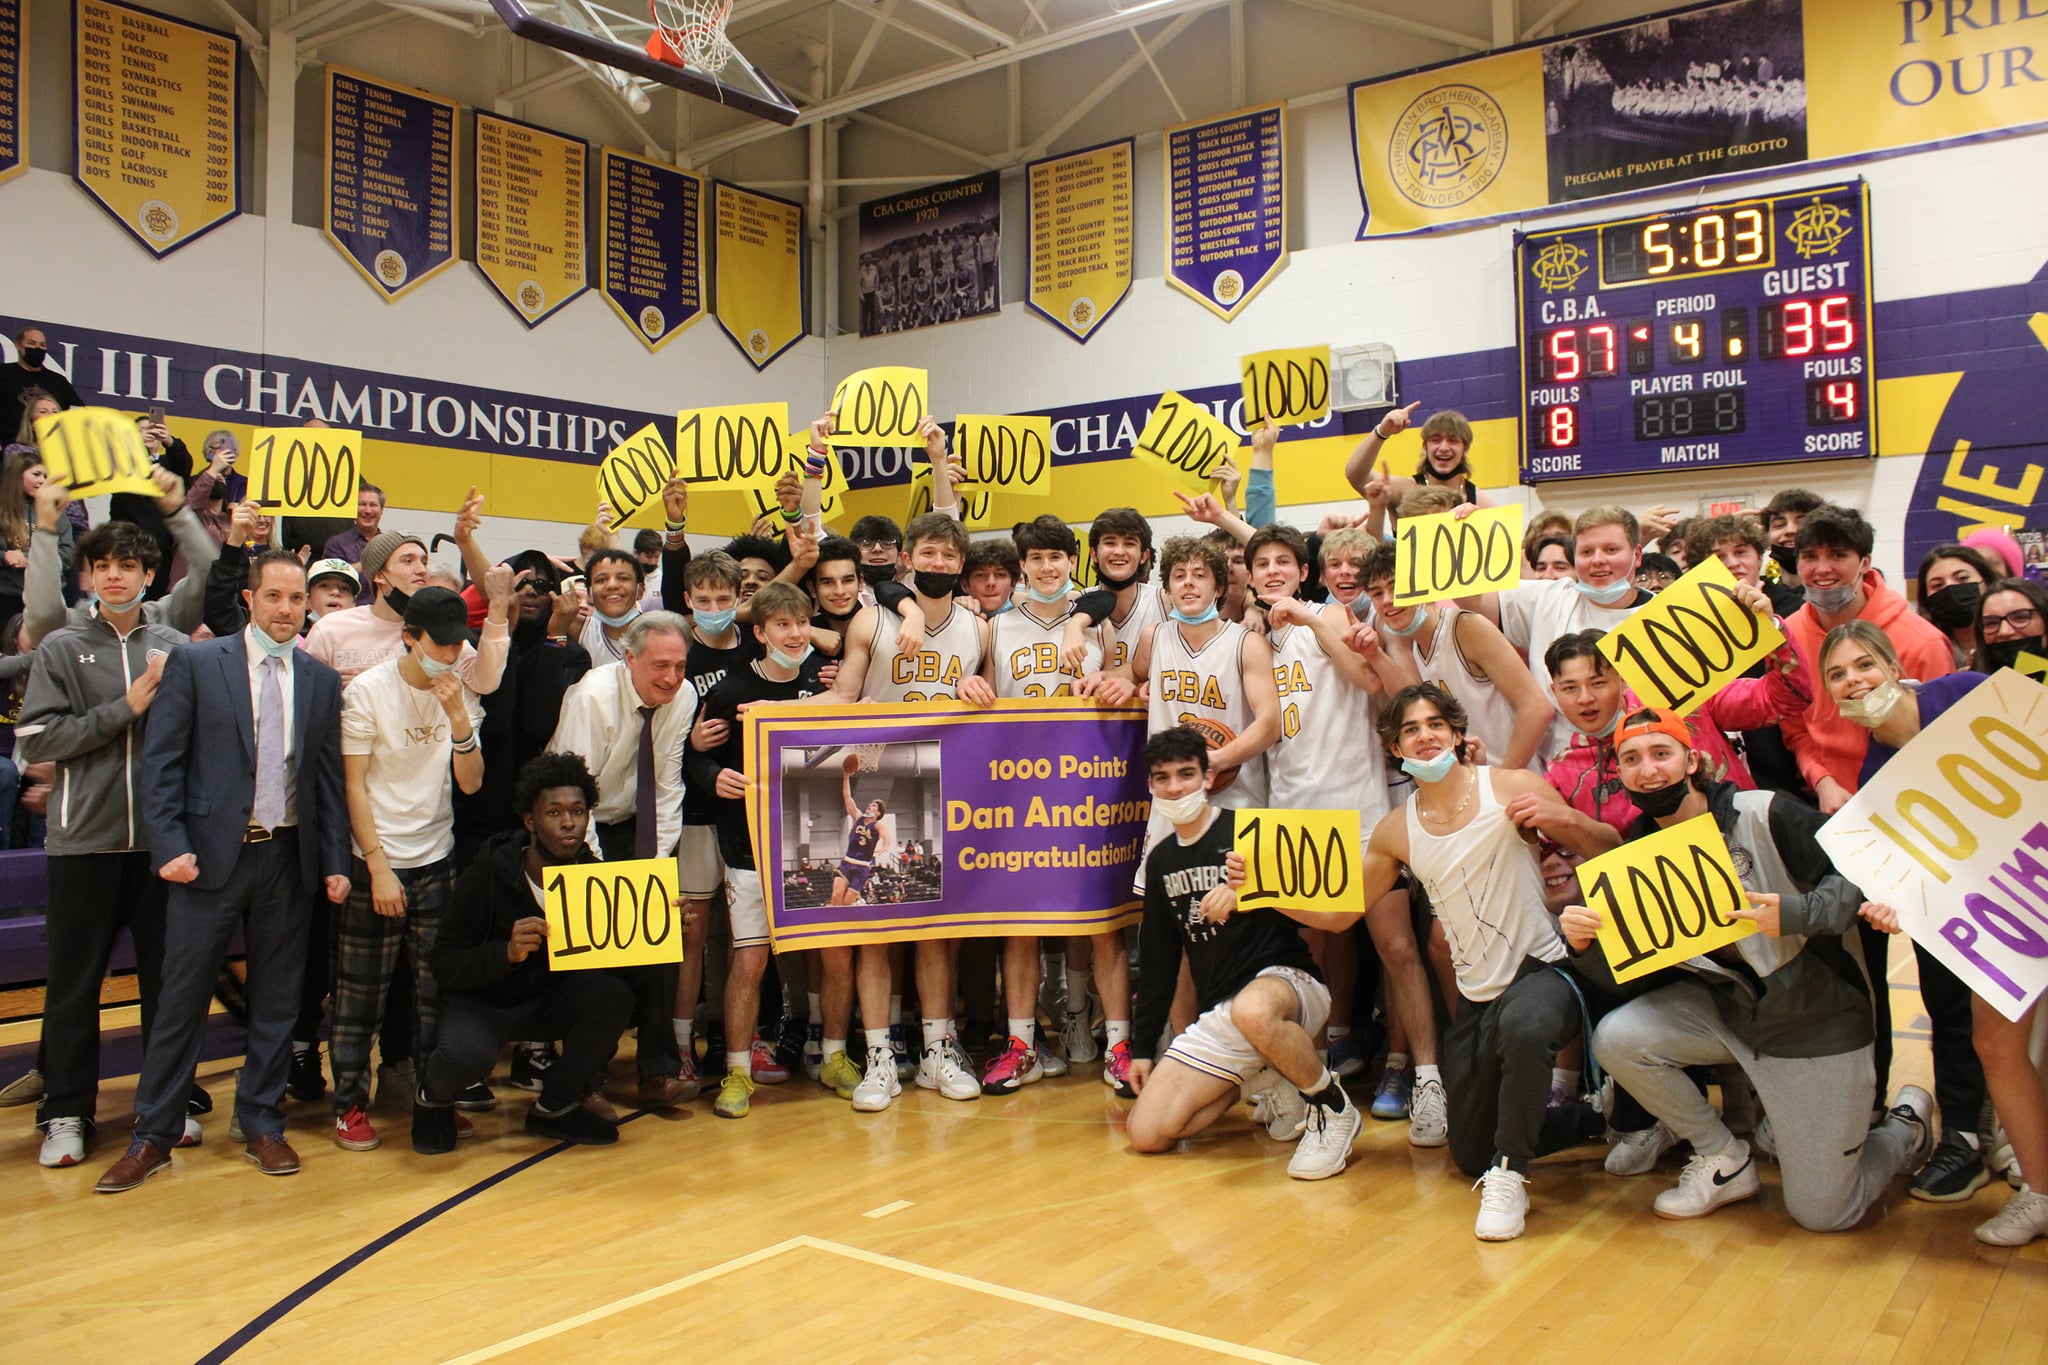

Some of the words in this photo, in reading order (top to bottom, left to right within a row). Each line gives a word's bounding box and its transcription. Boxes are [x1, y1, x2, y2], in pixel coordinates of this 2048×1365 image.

[84, 5, 111, 20] BOYS
[121, 15, 170, 38] BASEBALL
[208, 41, 229, 55] 2006
[84, 19, 114, 34] GIRLS
[121, 29, 146, 43] GOLF
[208, 54, 229, 67] 2006
[84, 32, 111, 47] BOYS
[121, 42, 169, 63] LACROSSE
[208, 66, 229, 80] 2006
[84, 45, 111, 60] BOYS
[121, 55, 156, 73] TENNIS
[208, 79, 228, 92] 2006
[84, 58, 111, 73] BOYS
[121, 68, 182, 92] GYMNASTICS
[208, 91, 228, 105] 2006
[85, 71, 111, 86] BOYS
[121, 82, 158, 98] SOCCER
[207, 104, 228, 117] 2006
[336, 79, 360, 93] GIRLS
[365, 87, 392, 102] TENNIS
[1889, 46, 2047, 107] OUR
[85, 85, 114, 100] GIRLS
[121, 94, 175, 116] SWIMMING
[207, 117, 228, 130] 2006
[85, 98, 114, 113] GIRLS
[121, 107, 156, 124] TENNIS
[207, 129, 227, 142] 2006
[336, 90, 356, 104] BOYS
[365, 99, 407, 118] SWIMMING
[336, 102, 356, 115] BOYS
[364, 110, 402, 128] BASEBALL
[1394, 111, 1418, 176] CHRISTIAN
[1416, 90, 1481, 113] BROTHERS
[1480, 101, 1503, 160] ACADEMY
[1034, 179, 1049, 189] BOYS
[1055, 172, 1075, 183] CROSS
[1075, 166, 1104, 177] COUNTRY
[1564, 166, 1624, 188] PREGAME
[1626, 157, 1675, 177] PRAYER
[1677, 153, 1694, 167] AT
[1697, 147, 1725, 163] THE
[1727, 136, 1789, 157] GROTTO
[481, 176, 502, 188] GIRLS
[506, 183, 538, 198] LACROSSE
[481, 187, 499, 199] BOYS
[506, 193, 530, 206] TENNIS
[873, 203, 894, 218] CBA
[896, 194, 929, 212] CROSS
[931, 182, 984, 204] COUNTRY
[1034, 190, 1050, 199] BOYS
[1056, 183, 1075, 194] CROSS
[1076, 177, 1104, 189] COUNTRY
[1174, 201, 1192, 211] BOYS
[1198, 194, 1221, 206] CROSS
[1221, 187, 1254, 201] COUNTRY
[1263, 183, 1280, 193] 1969
[1406, 183, 1464, 204] FOUNDED
[1467, 168, 1493, 193] 1900
[916, 207, 940, 223] 1970
[1174, 212, 1193, 223] BOYS
[1199, 202, 1239, 217] WRESTLING
[1264, 195, 1280, 205] 1970
[1175, 223, 1193, 234] BOYS
[1200, 215, 1233, 229] OUTDOOR
[1234, 210, 1257, 222] TRACK
[1264, 206, 1280, 216] 1970
[1175, 234, 1193, 245] BOYS
[1200, 228, 1221, 240] CROSS
[1222, 222, 1256, 235] COUNTRY
[1265, 218, 1280, 228] 1970
[1175, 246, 1193, 256] BOYS
[1200, 237, 1240, 251] WRESTLING
[1265, 229, 1280, 240] 1971
[1644, 209, 1763, 274] 5:03
[1175, 257, 1194, 267] BOYS
[1200, 250, 1234, 263] OUTDOOR
[1235, 245, 1259, 256] TRACK
[1265, 241, 1280, 251] 1971
[609, 271, 625, 281] BOYS
[630, 276, 667, 290] BASKETBALL
[609, 281, 627, 292] GIRLS
[630, 286, 660, 299] LACROSSE
[1763, 262, 1850, 297] GUEST
[1541, 295, 1607, 324] C.B.A.
[1655, 294, 1716, 317] PERIOD
[1674, 323, 1700, 358] 4
[1783, 296, 1853, 356] 35
[1551, 326, 1614, 380] 57
[1804, 357, 1862, 379] FOULS
[97, 347, 175, 403] III
[203, 363, 626, 454] CHAMPIONSHIPS
[1244, 358, 1328, 426] 1000
[1530, 386, 1580, 406] FOULS
[1630, 374, 1693, 396] PLAYER
[1702, 369, 1747, 389] FOUL
[1828, 383, 1854, 418] 4
[829, 380, 922, 437] 1000
[1550, 407, 1574, 446] 8
[681, 413, 782, 483] 1000
[958, 423, 1045, 486] 1000
[1139, 402, 1229, 480] 1000
[1661, 443, 1720, 464] MATCH
[1804, 431, 1863, 453] SCORE
[255, 434, 355, 510] 1000
[1532, 455, 1582, 474] SCORE
[599, 437, 674, 530] 1000
[1395, 520, 1514, 599] 1000
[1614, 582, 1759, 710] 1000
[892, 650, 963, 687] CBA
[1161, 670, 1226, 710] CBA
[403, 724, 447, 747] NYC
[1283, 702, 1301, 739] 0
[988, 758, 1052, 782] 1000
[1059, 755, 1128, 779] Points
[946, 799, 1015, 832] Dan
[1024, 795, 1150, 828] Anderson
[1868, 716, 2048, 885] 1000
[957, 837, 1138, 874] Congratulations!
[1238, 817, 1348, 902] 1000
[1163, 865, 1229, 898] BROTHERS
[548, 873, 671, 958] 1000
[1589, 844, 1740, 972] 1000
